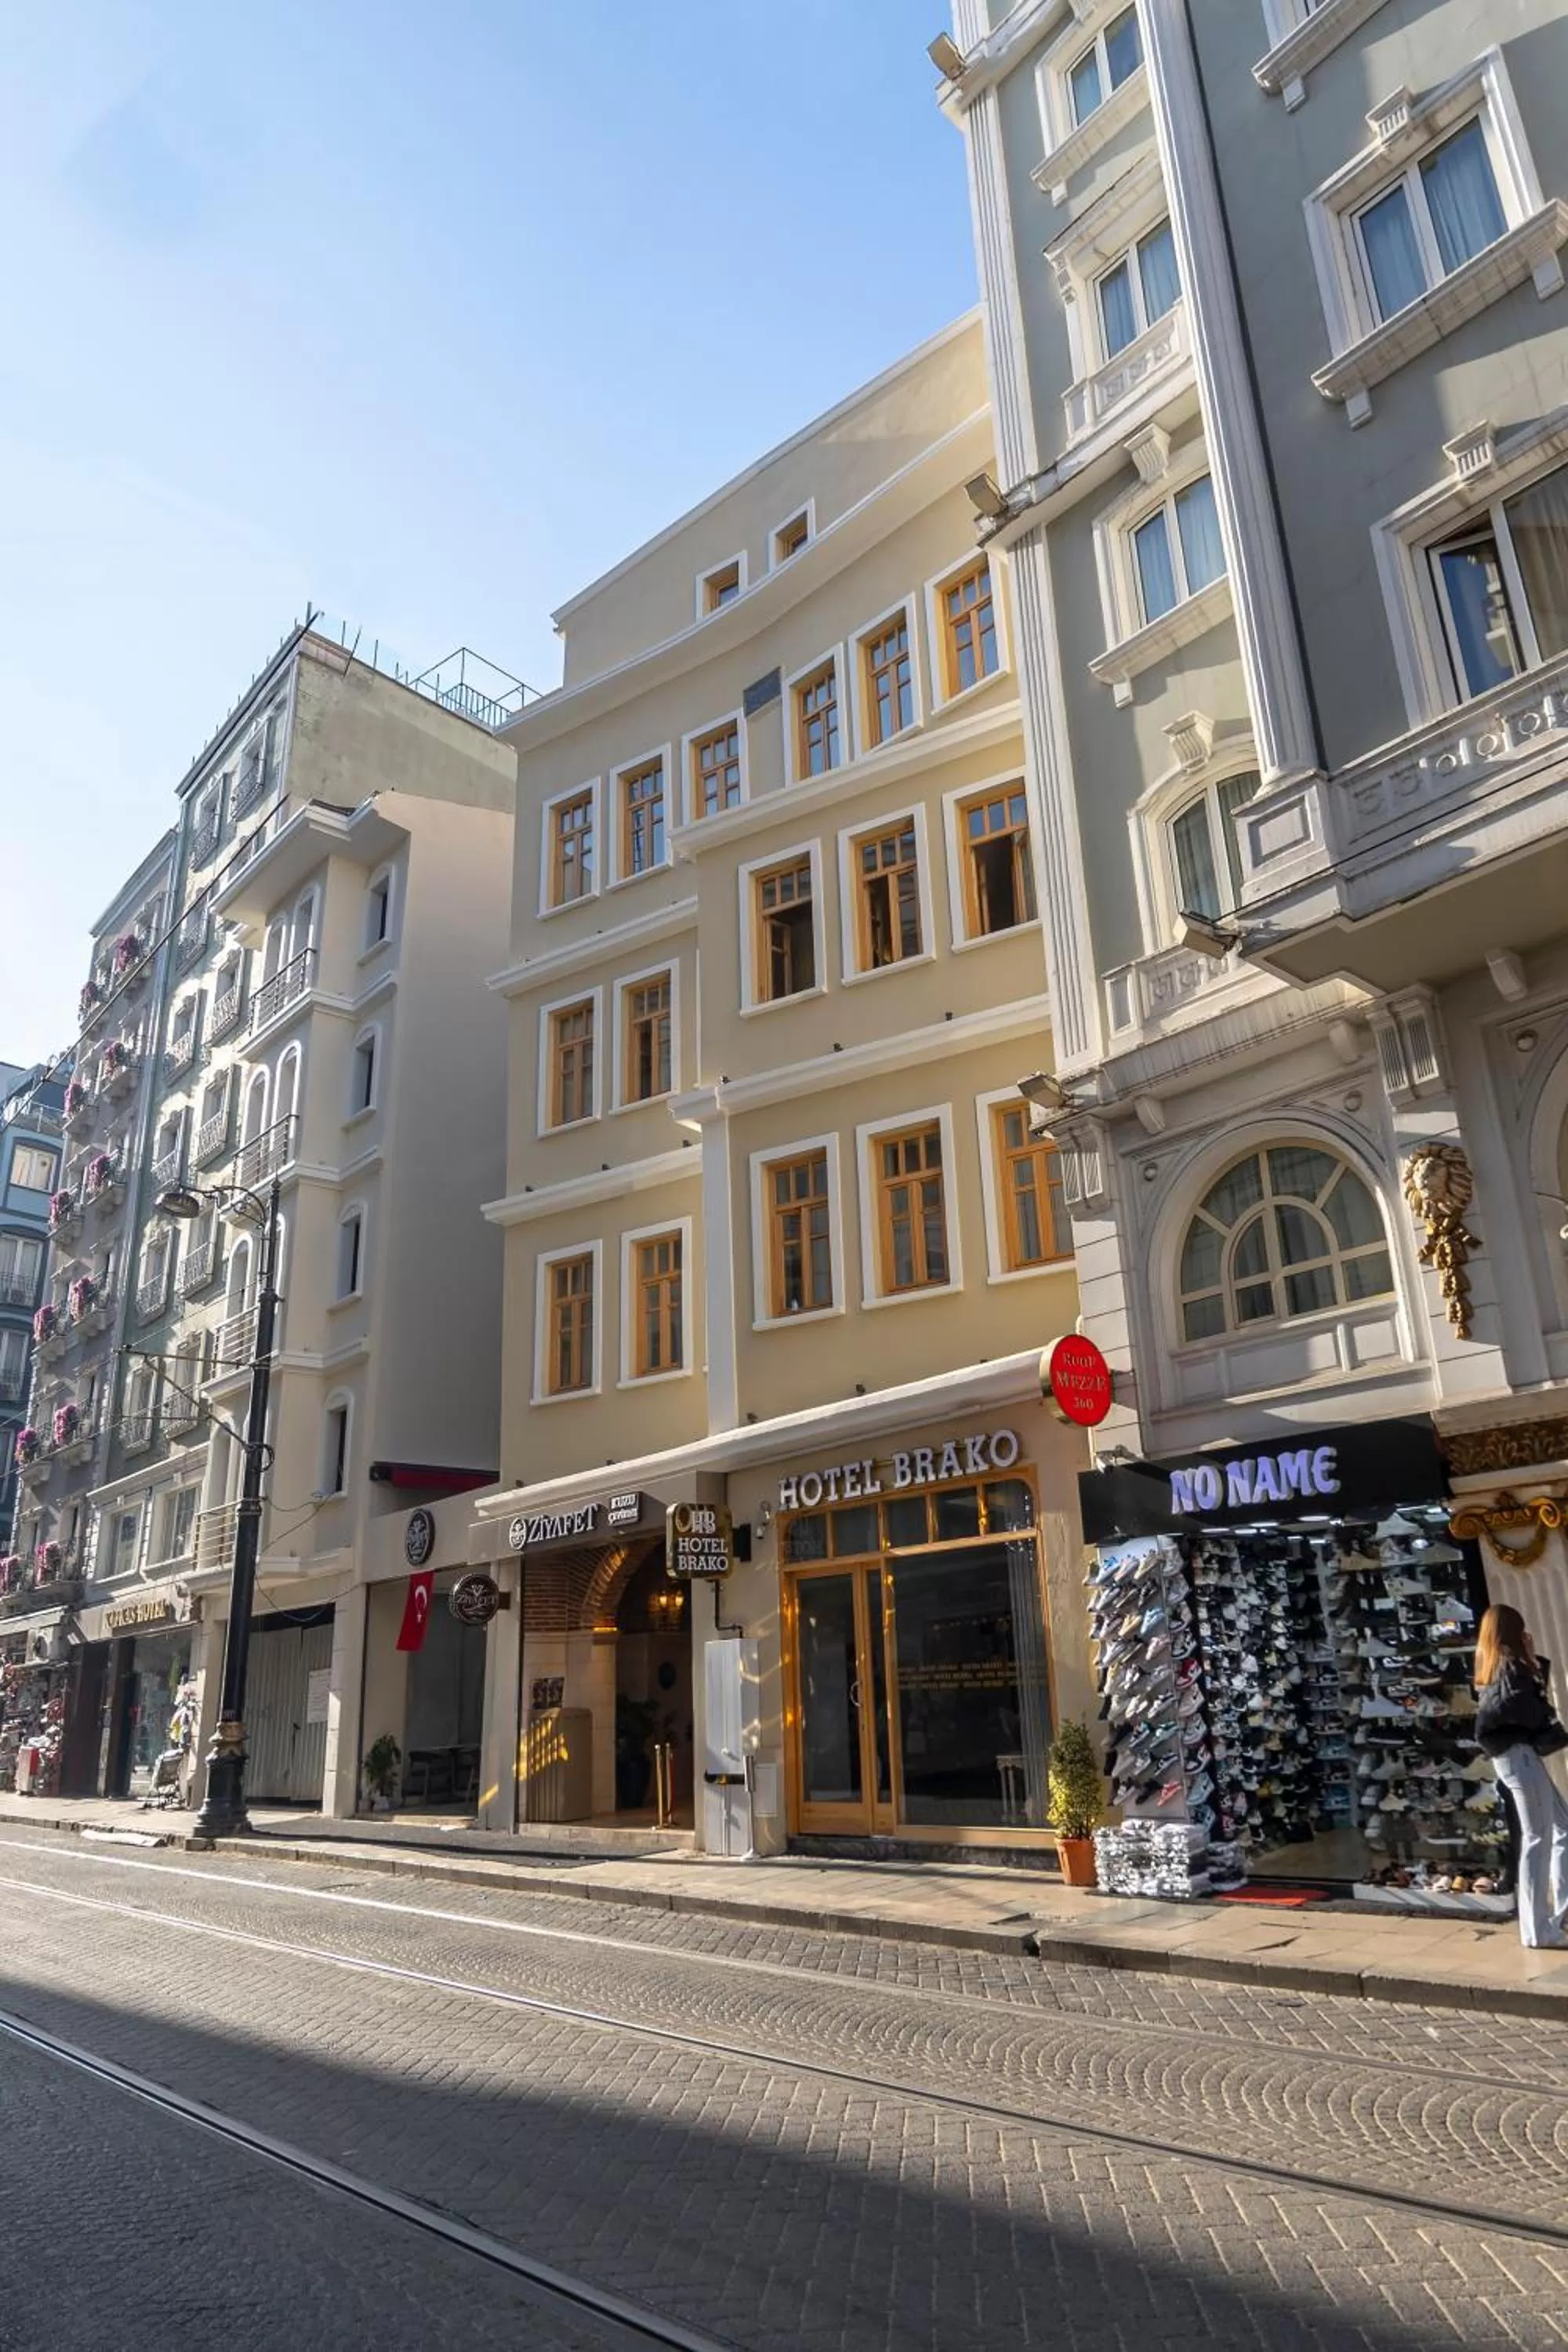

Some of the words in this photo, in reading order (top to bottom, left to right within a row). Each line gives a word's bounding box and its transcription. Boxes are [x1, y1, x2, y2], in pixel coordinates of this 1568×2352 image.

[779, 1459, 881, 1511] HOTEL
[891, 1428, 1018, 1489] BRAKO
[1169, 1465, 1223, 1515] NO
[1225, 1446, 1341, 1508] NAME
[677, 1537, 728, 1553] HOTEL
[677, 1555, 728, 1571] BRAKO
